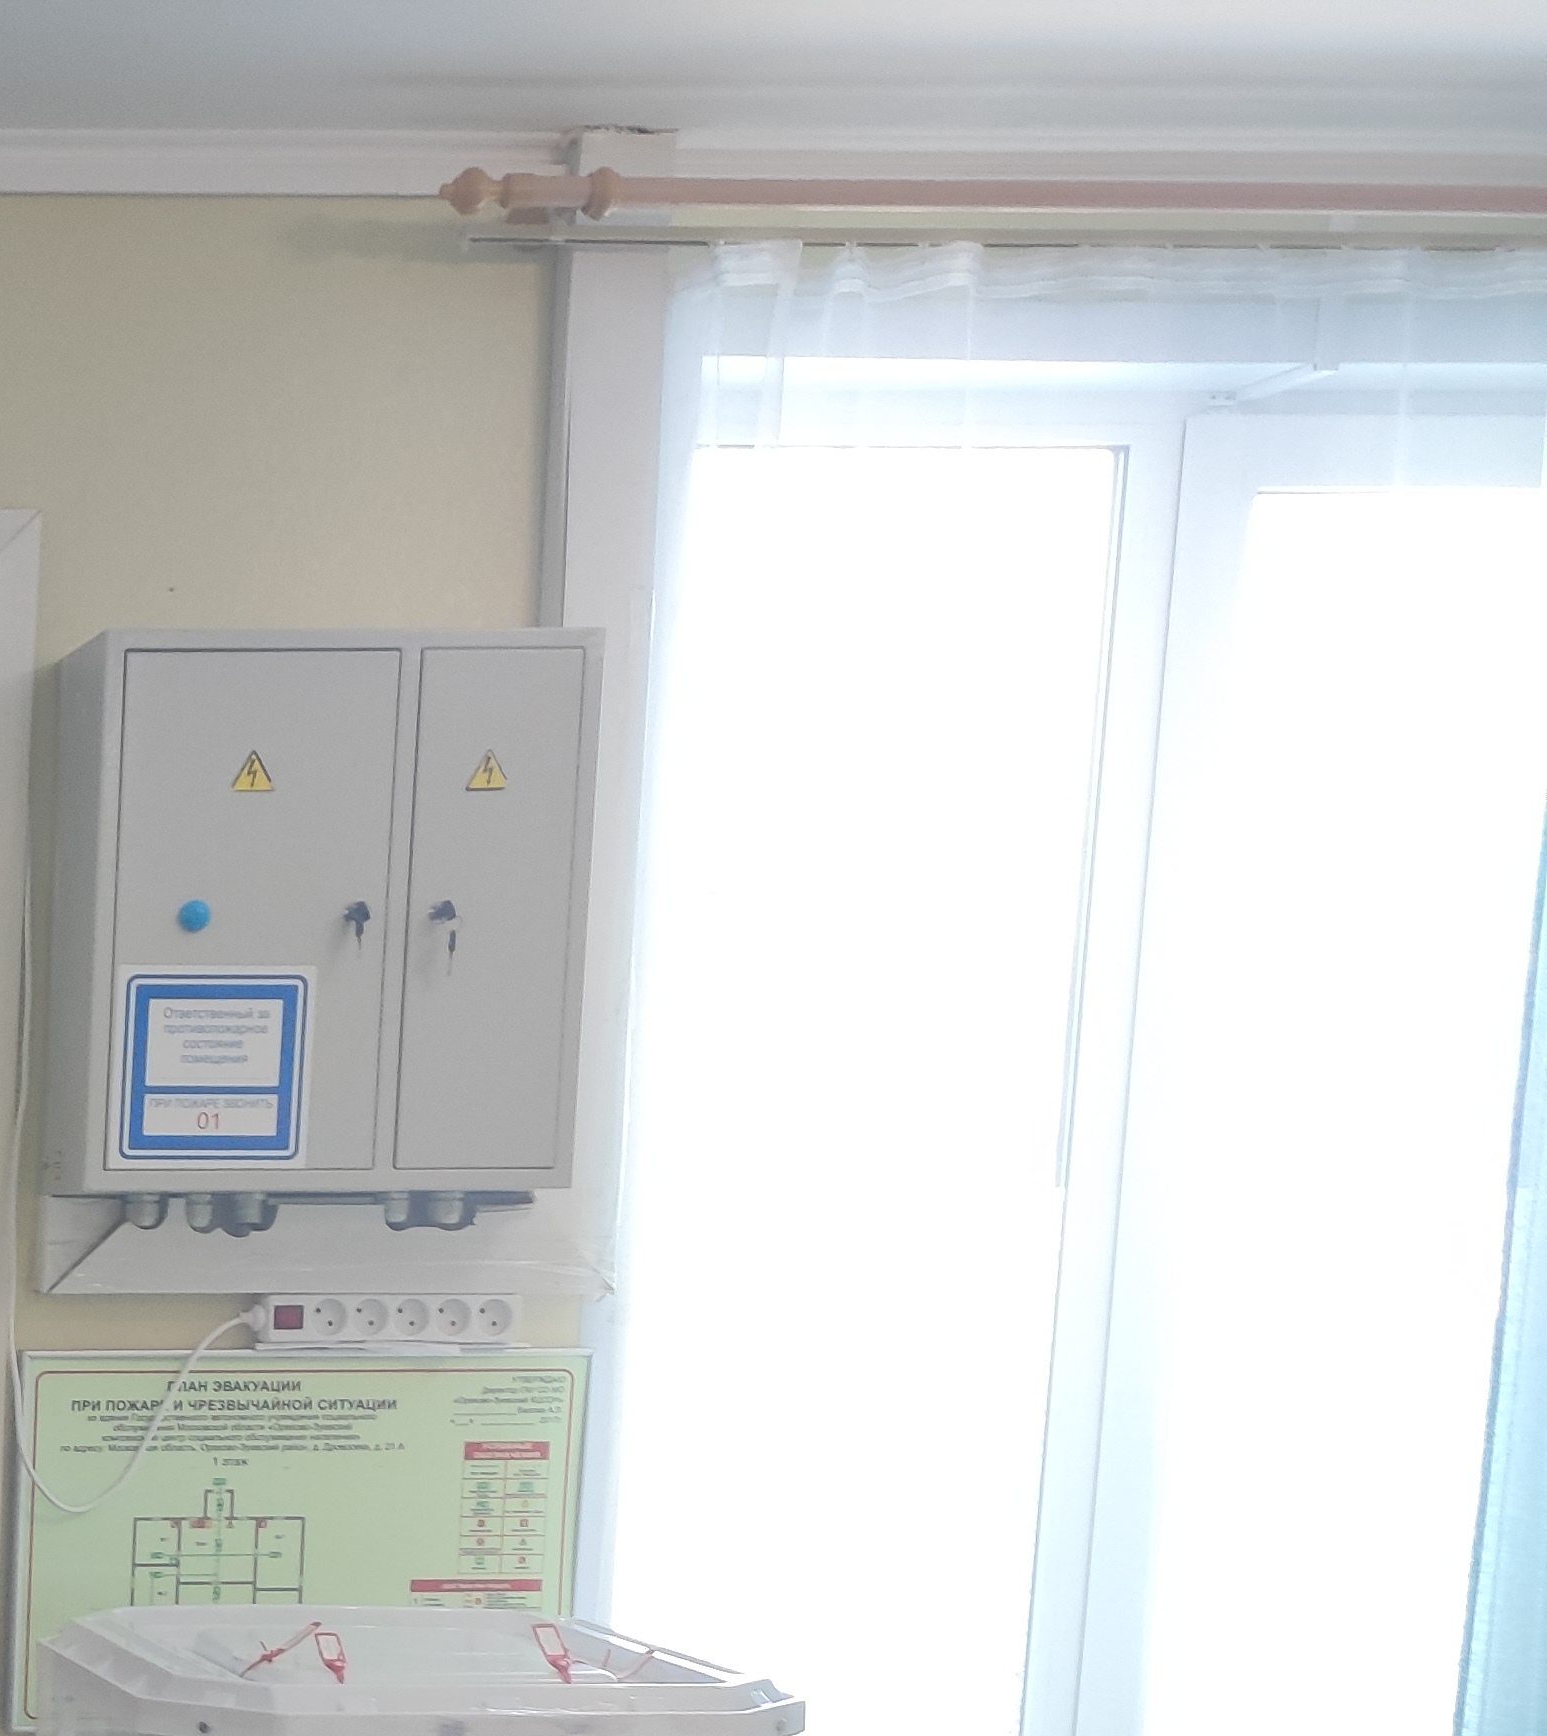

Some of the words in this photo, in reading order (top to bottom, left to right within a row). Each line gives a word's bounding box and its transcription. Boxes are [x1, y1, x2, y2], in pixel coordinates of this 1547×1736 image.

[197, 1112, 220, 1130] 01
[212, 1380, 301, 1393] ЭВАКУАЦИИ
[71, 1400, 101, 1412] ПРИ
[105, 1400, 169, 1412] ПОЖАР
[173, 1400, 183, 1411] И
[188, 1397, 312, 1412] ЧРЕЗВЫЧАЙНОЙ
[317, 1398, 397, 1412] СИТУАЦИИ
